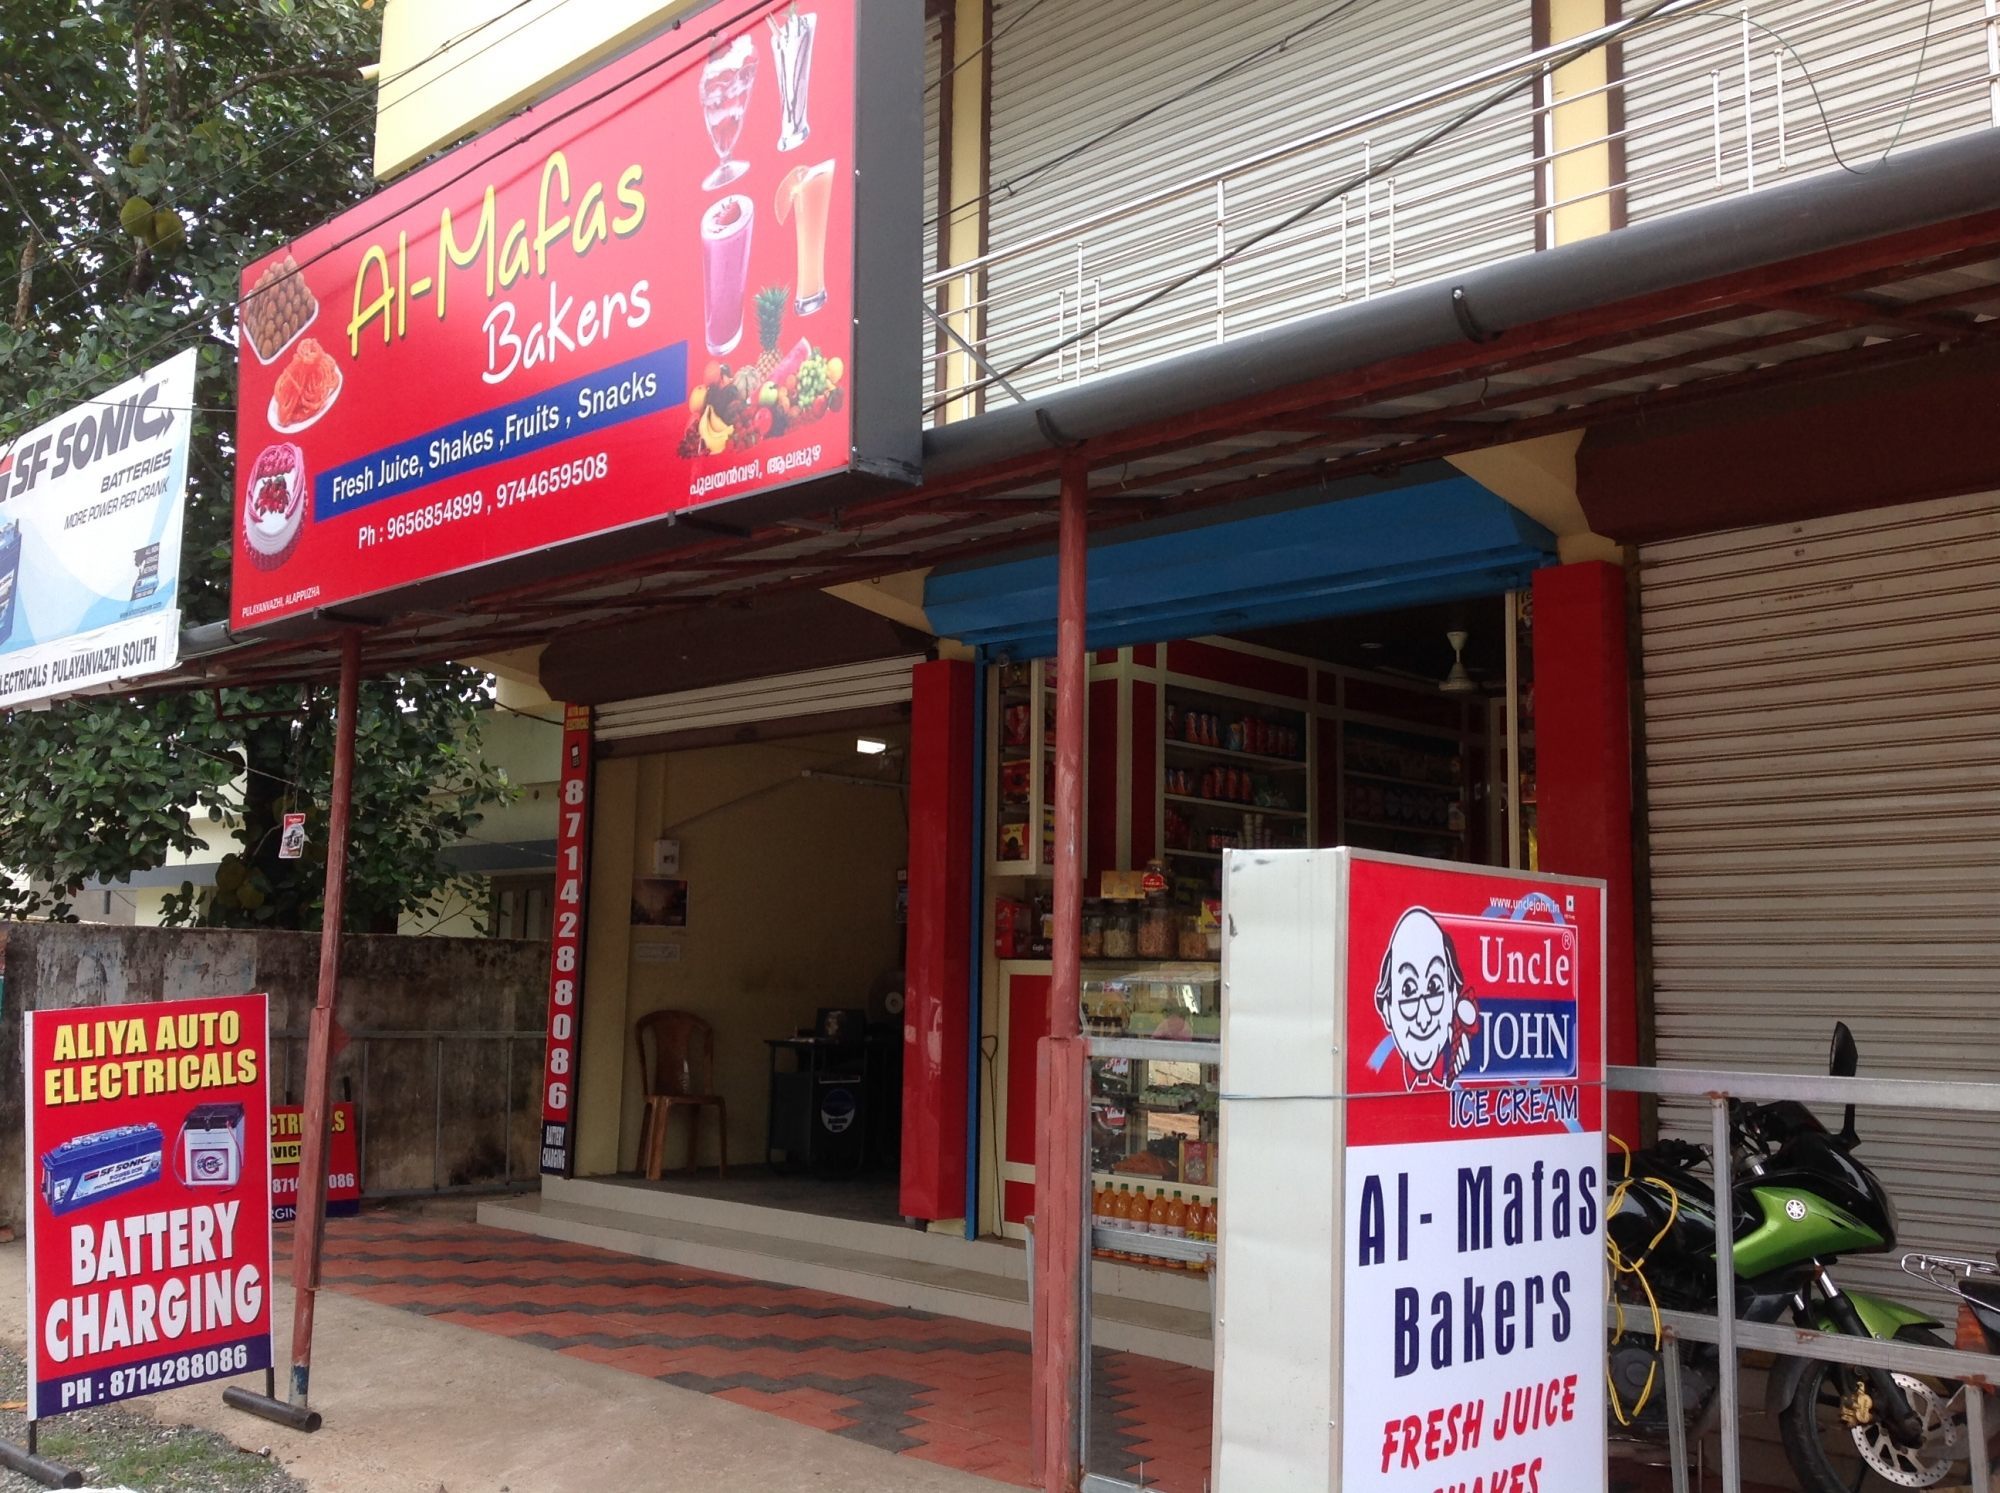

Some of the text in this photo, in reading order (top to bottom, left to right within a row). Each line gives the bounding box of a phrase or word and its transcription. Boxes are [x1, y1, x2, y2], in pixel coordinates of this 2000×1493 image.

[346, 150, 647, 358] Al-Mafas
[481, 279, 651, 385] Bakers
[10, 434, 53, 499] SF
[51, 383, 175, 480] SONIC
[332, 465, 374, 503] Fresh
[377, 452, 424, 488] Juice,
[428, 425, 493, 469] Shakes
[577, 371, 657, 418] Snacks
[100, 448, 173, 493] BATTERIES
[358, 524, 376, 549] Ph
[386, 490, 483, 541] 9656854899
[496, 451, 608, 510] 9744659508
[64, 476, 170, 530] MORE POWER PER CRANK
[284, 585, 320, 606] ALAPPUZHA
[0, 635, 157, 696] LECTRICALS PULAYANVAZHI SOUTH
[1489, 896, 1560, 916] www.unclejohn.in
[1479, 934, 1570, 987] Uncle
[53, 1010, 240, 1062] ALIYA AUTO
[1478, 1010, 1570, 1073] JOHN
[43, 1048, 258, 1107] ELECTRICALS
[1449, 1084, 1579, 1129] ICE CREAM
[1457, 1159, 1598, 1253] Mafas
[70, 1199, 241, 1287] BATTERY
[44, 1262, 263, 1363] CHARGING
[1393, 1270, 1572, 1379] Bakers
[61, 1379, 91, 1408] PH
[110, 1344, 248, 1398] 8714288086
[1380, 1373, 1578, 1474] FRESH JUICE
